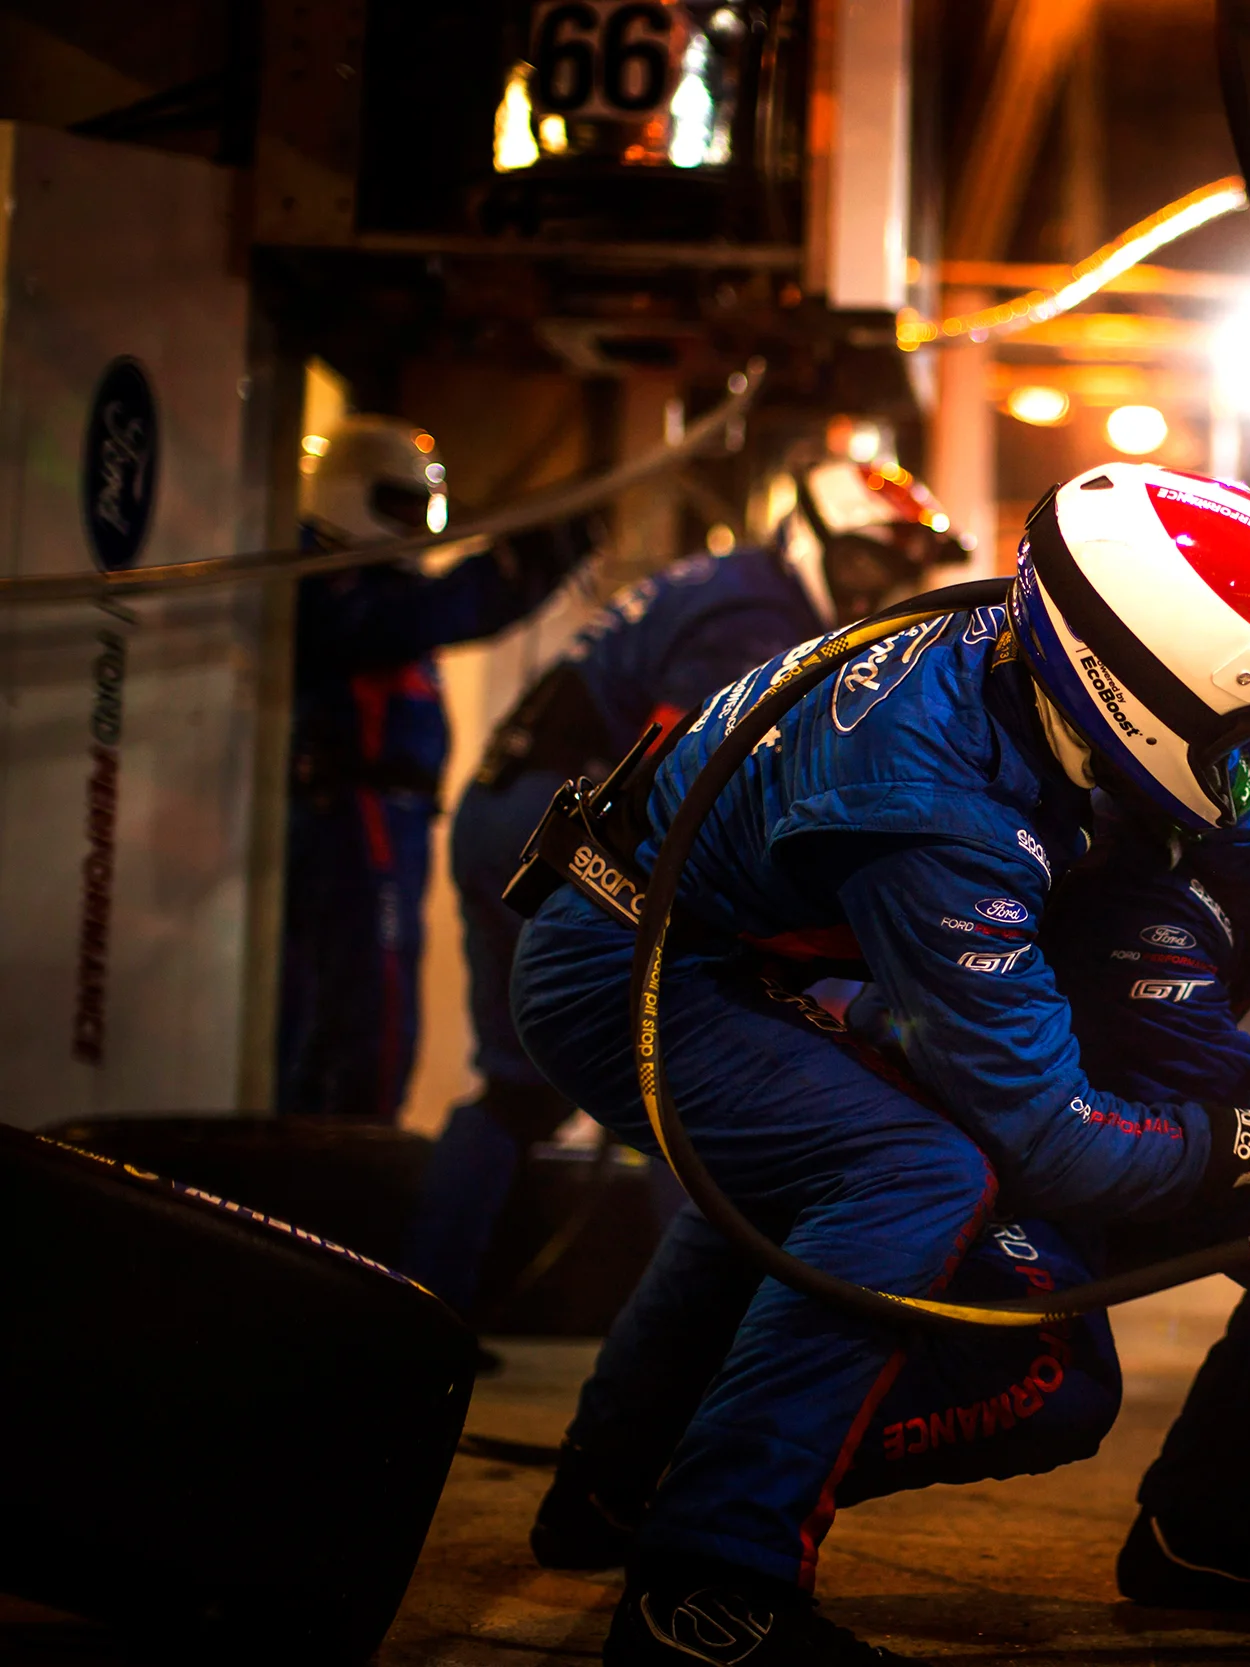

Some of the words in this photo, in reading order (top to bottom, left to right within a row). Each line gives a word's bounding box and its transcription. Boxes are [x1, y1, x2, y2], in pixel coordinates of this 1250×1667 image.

[541, 4, 669, 109] 66
[88, 630, 125, 745] FORD
[1080, 655, 1140, 737] EcoBoost
[1096, 659, 1121, 692] owered
[1116, 691, 1127, 704] by
[573, 845, 648, 916] sparc
[72, 746, 119, 1067] PERFORMANCE
[941, 917, 974, 932] FORD
[986, 901, 1021, 920] Ford
[1109, 950, 1141, 961] FORD
[1151, 927, 1188, 947] Ford
[957, 944, 1031, 975] GT
[644, 991, 658, 1017] pit
[1129, 979, 1215, 1003] GT
[638, 1018, 657, 1058] stop
[990, 1222, 1040, 1262] RD
[883, 1264, 1071, 1462] PFORMANCE
